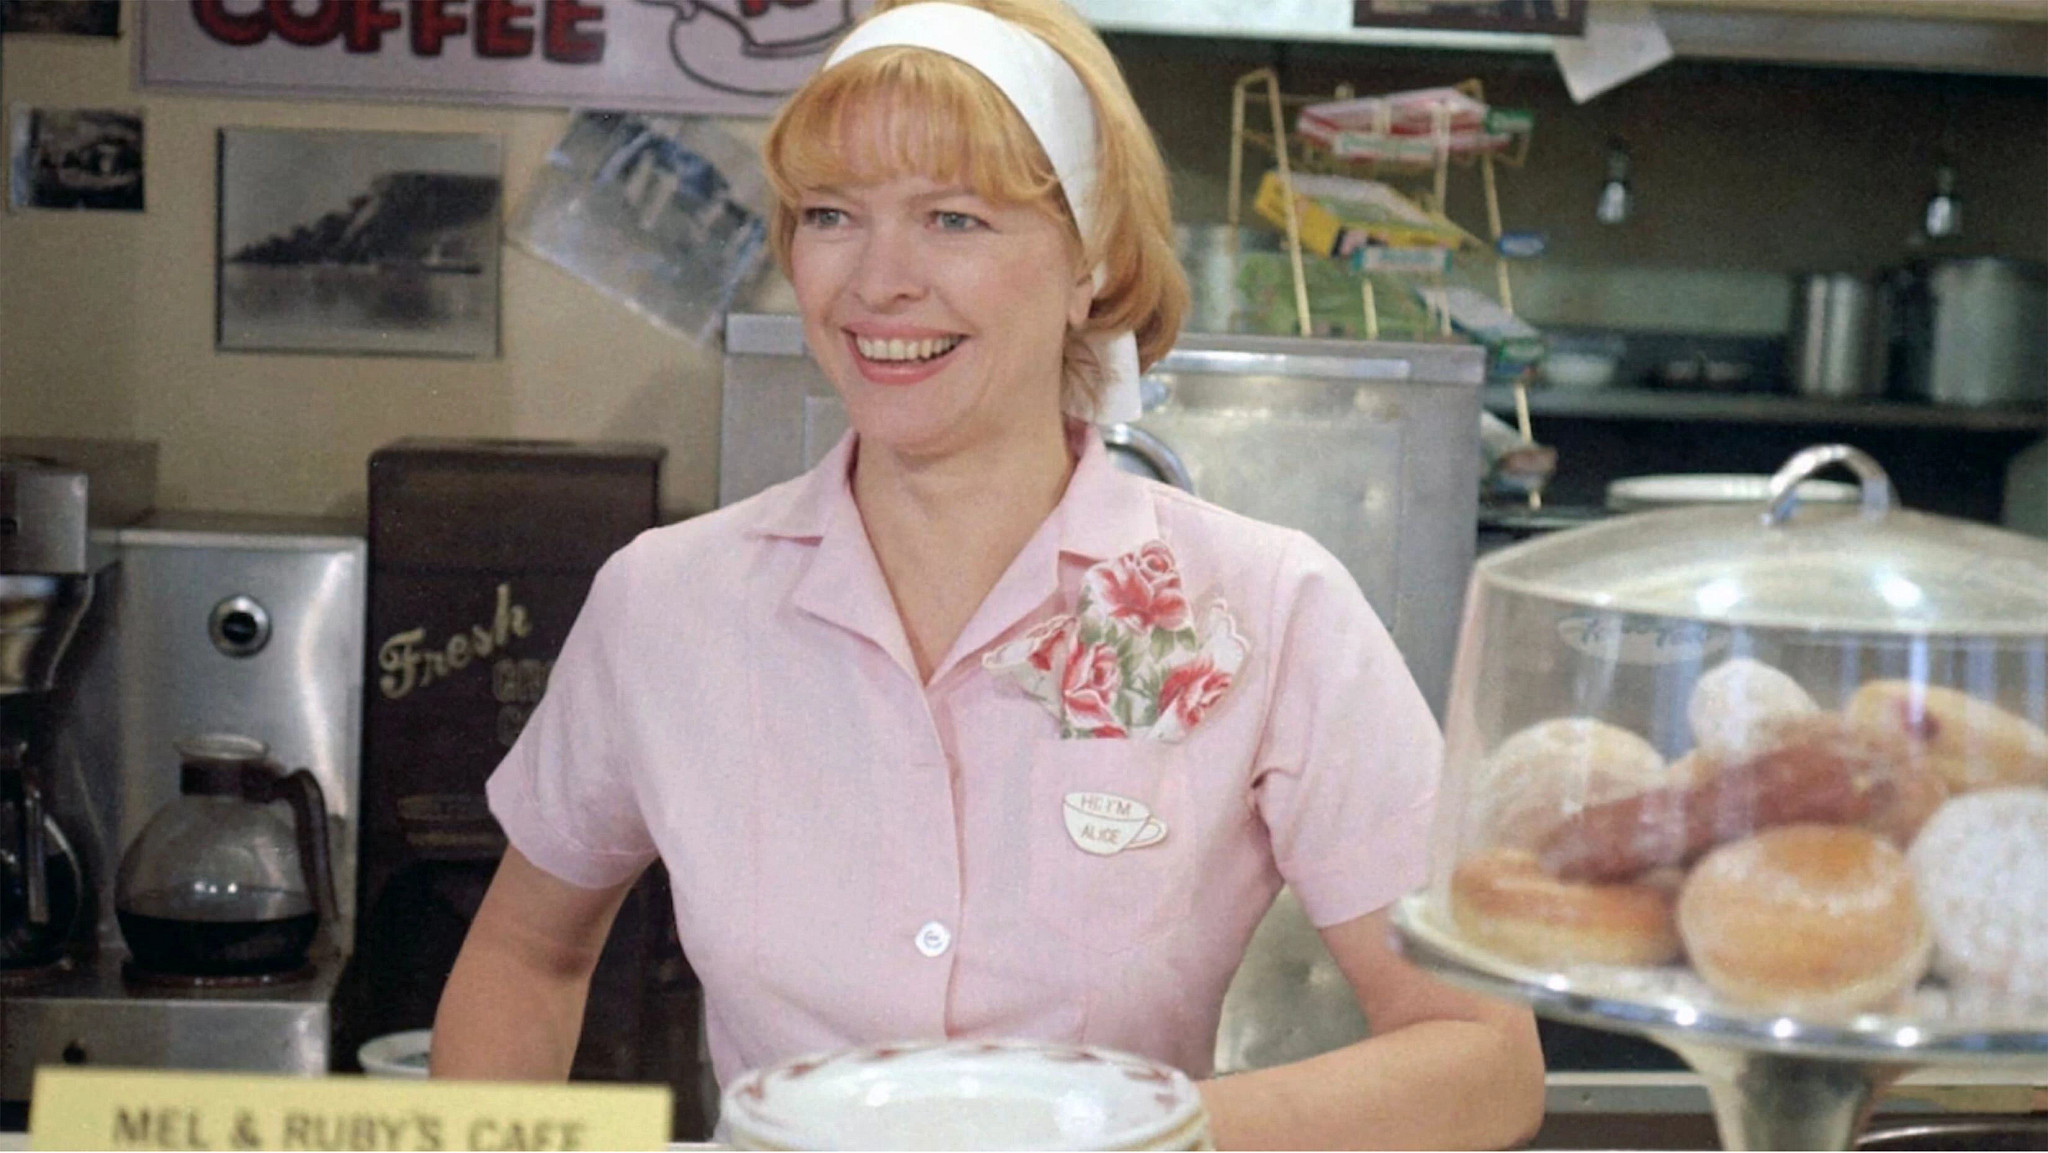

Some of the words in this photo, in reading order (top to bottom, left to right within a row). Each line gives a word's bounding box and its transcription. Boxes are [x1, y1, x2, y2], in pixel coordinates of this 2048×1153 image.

[378, 583, 533, 699] Fresh
[1080, 823, 1122, 845] ALICE
[111, 1105, 210, 1149] MEL
[229, 1105, 263, 1149] &
[282, 1109, 444, 1151] RUBY'S
[466, 1114, 586, 1151] CAFE
